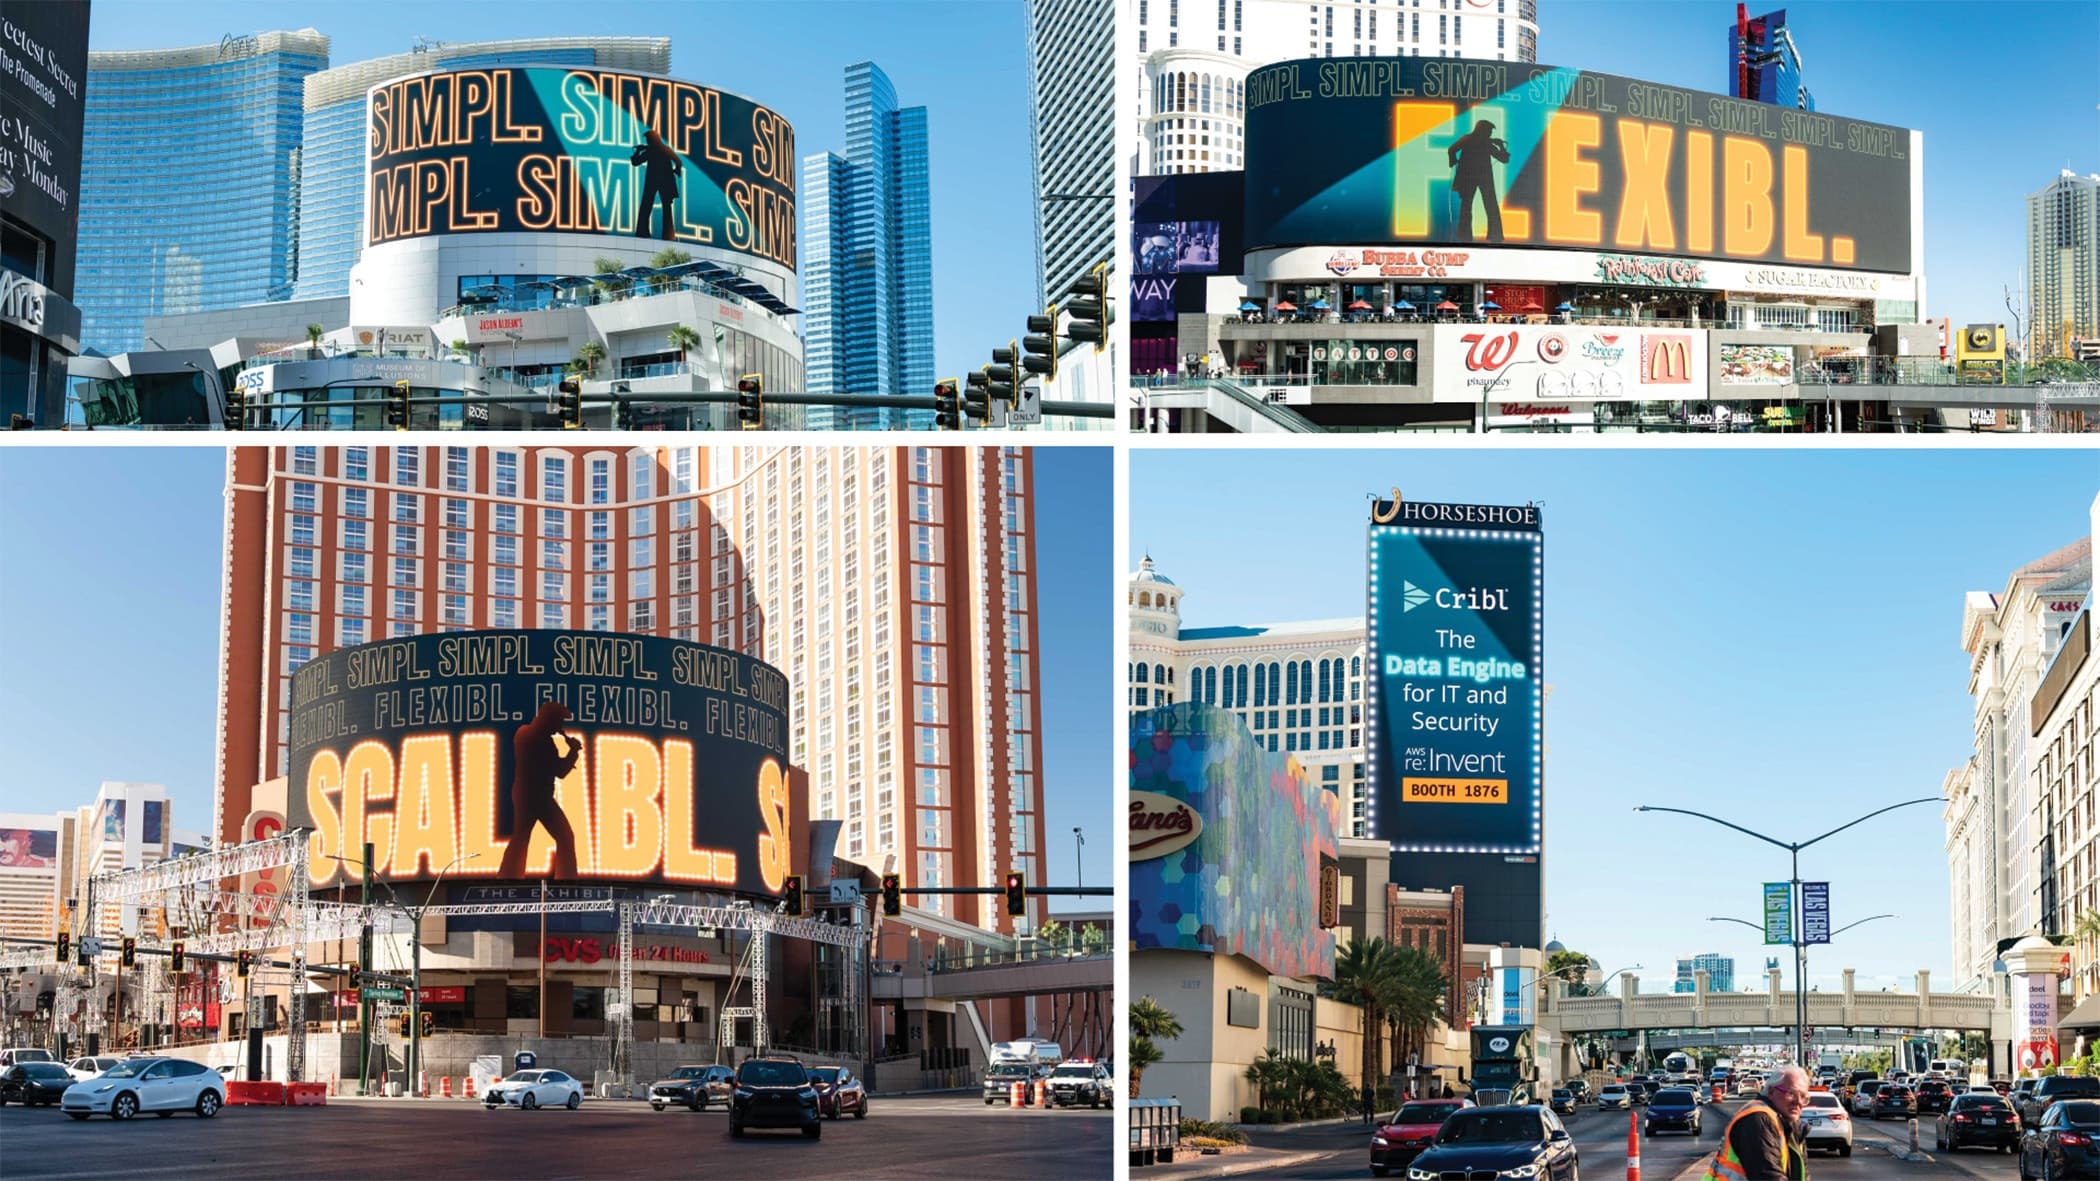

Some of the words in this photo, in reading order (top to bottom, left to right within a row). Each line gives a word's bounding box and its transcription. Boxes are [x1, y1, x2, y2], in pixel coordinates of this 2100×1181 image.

[1, 17, 45, 67] eetest
[48, 50, 77, 100] Secret
[15, 60, 57, 109] Promenade
[372, 69, 543, 161] SIMPL.
[561, 71, 743, 167] SIMPL.
[1250, 65, 1313, 110] SIMPL.
[1319, 62, 1415, 99] SIMPL.
[1423, 62, 1521, 102] SIMPL.
[1527, 68, 1618, 113] SIMPL.
[1627, 82, 1704, 127] SIMPL.
[1708, 99, 1778, 138] SIMPL.
[1780, 111, 1844, 150] SIMPL.
[1848, 122, 1906, 160] SIMPL.
[14, 117, 53, 167] Music
[1393, 102, 1857, 265] FLEXIBL.
[371, 156, 500, 242] MPL.
[1361, 249, 1419, 265] BUBBA
[1422, 250, 1470, 266] GUMP
[1380, 265, 1426, 276] SHRIMP
[1603, 256, 1668, 284] Rainforest
[1757, 270, 1806, 287] SUGAR
[1808, 272, 1868, 290] FACTORY
[0, 270, 45, 327] Aria
[376, 364, 413, 372] MUSEUM
[1467, 377, 1512, 388] pharmacy
[468, 405, 488, 420] ROSS
[1013, 412, 1035, 421] ONLY
[1501, 402, 1572, 420] Walgreens
[1688, 415, 1712, 424] TACO
[1731, 413, 1754, 423] BELL
[1404, 503, 1534, 525] HORSESHOE
[1435, 587, 1509, 611] Cribl
[1436, 629, 1476, 649] The
[346, 641, 431, 690] SIMPL.
[438, 636, 545, 687] SIMPL.
[553, 635, 658, 681] SIMPL.
[672, 645, 748, 698] SIMPL.
[1385, 655, 1442, 677] Data
[1447, 656, 1526, 682] Engine
[1403, 683, 1435, 702] for
[1441, 685, 1461, 703] IT
[1466, 686, 1507, 705] and
[373, 682, 523, 730] FLEXIBL.
[705, 697, 785, 756] FLEXIBL.
[1411, 711, 1500, 737] Security
[1405, 747, 1427, 757] AWS
[1411, 784, 1456, 797] BOOTH
[1464, 785, 1500, 798] 1876
[479, 888, 518, 899] THE
[530, 887, 614, 899] EXHIBIT
[1767, 892, 1790, 910] LAS
[1804, 891, 1828, 910] LAS
[1767, 911, 1790, 942] VEGAS
[1804, 911, 1828, 941] VEGAS
[538, 936, 601, 964] CVS
[607, 944, 648, 961] Oen
[651, 945, 670, 961] 24
[673, 945, 711, 963] Hours
